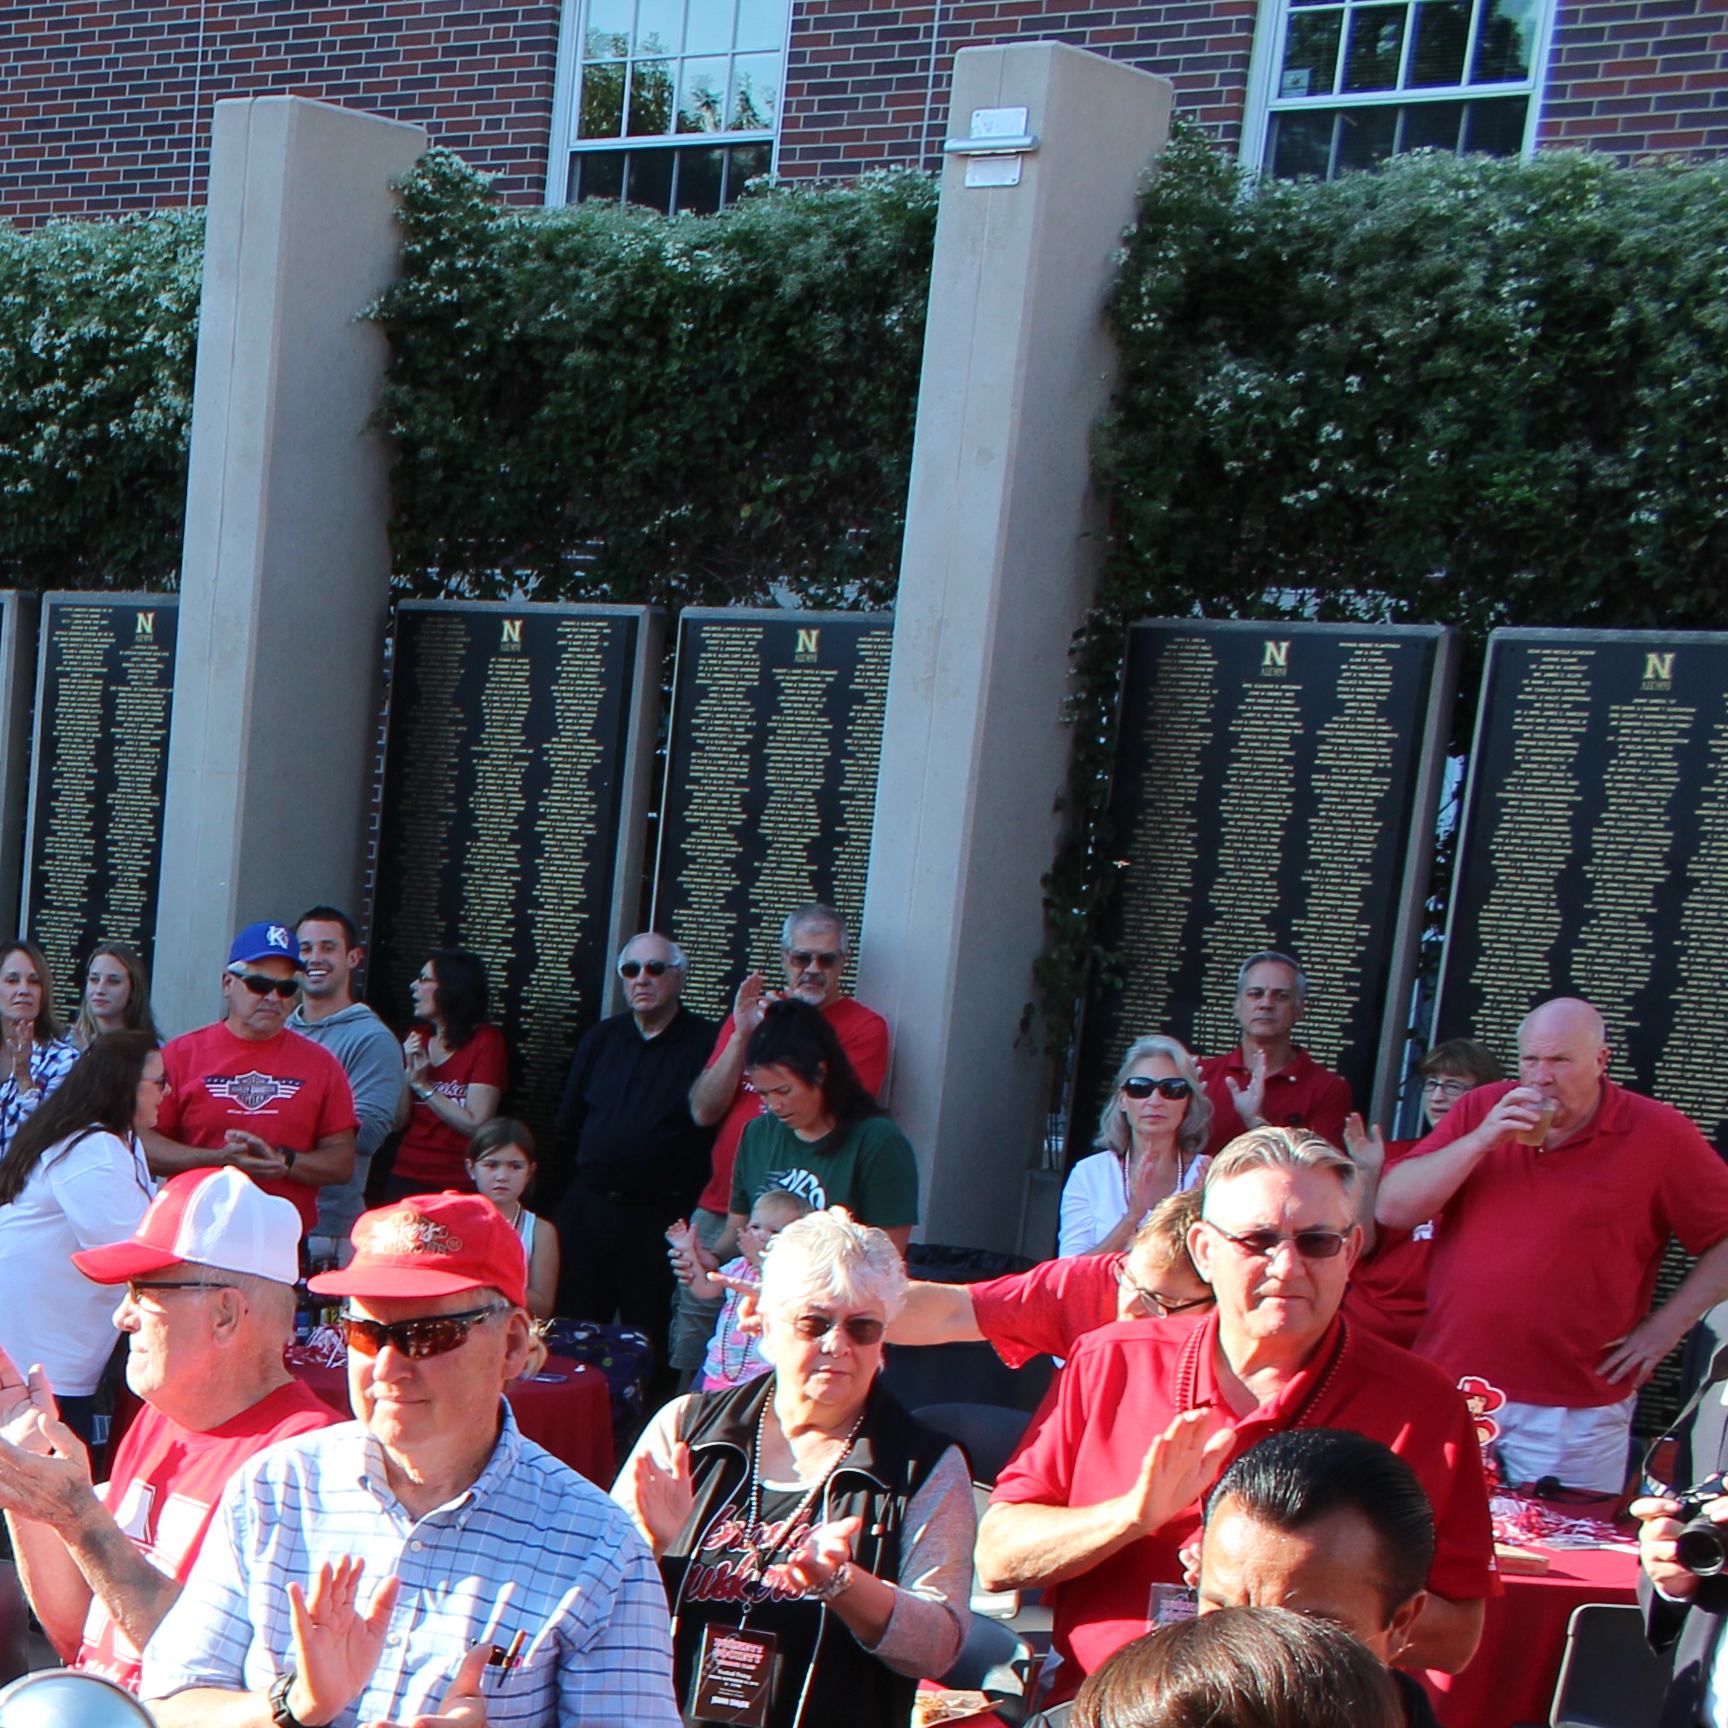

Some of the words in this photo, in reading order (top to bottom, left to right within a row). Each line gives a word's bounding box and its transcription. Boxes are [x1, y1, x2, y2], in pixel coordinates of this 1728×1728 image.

[135, 612, 154, 633] N
[501, 620, 523, 642] N
[795, 629, 820, 653] N
[1262, 641, 1291, 666] N
[1643, 653, 1676, 679] N
